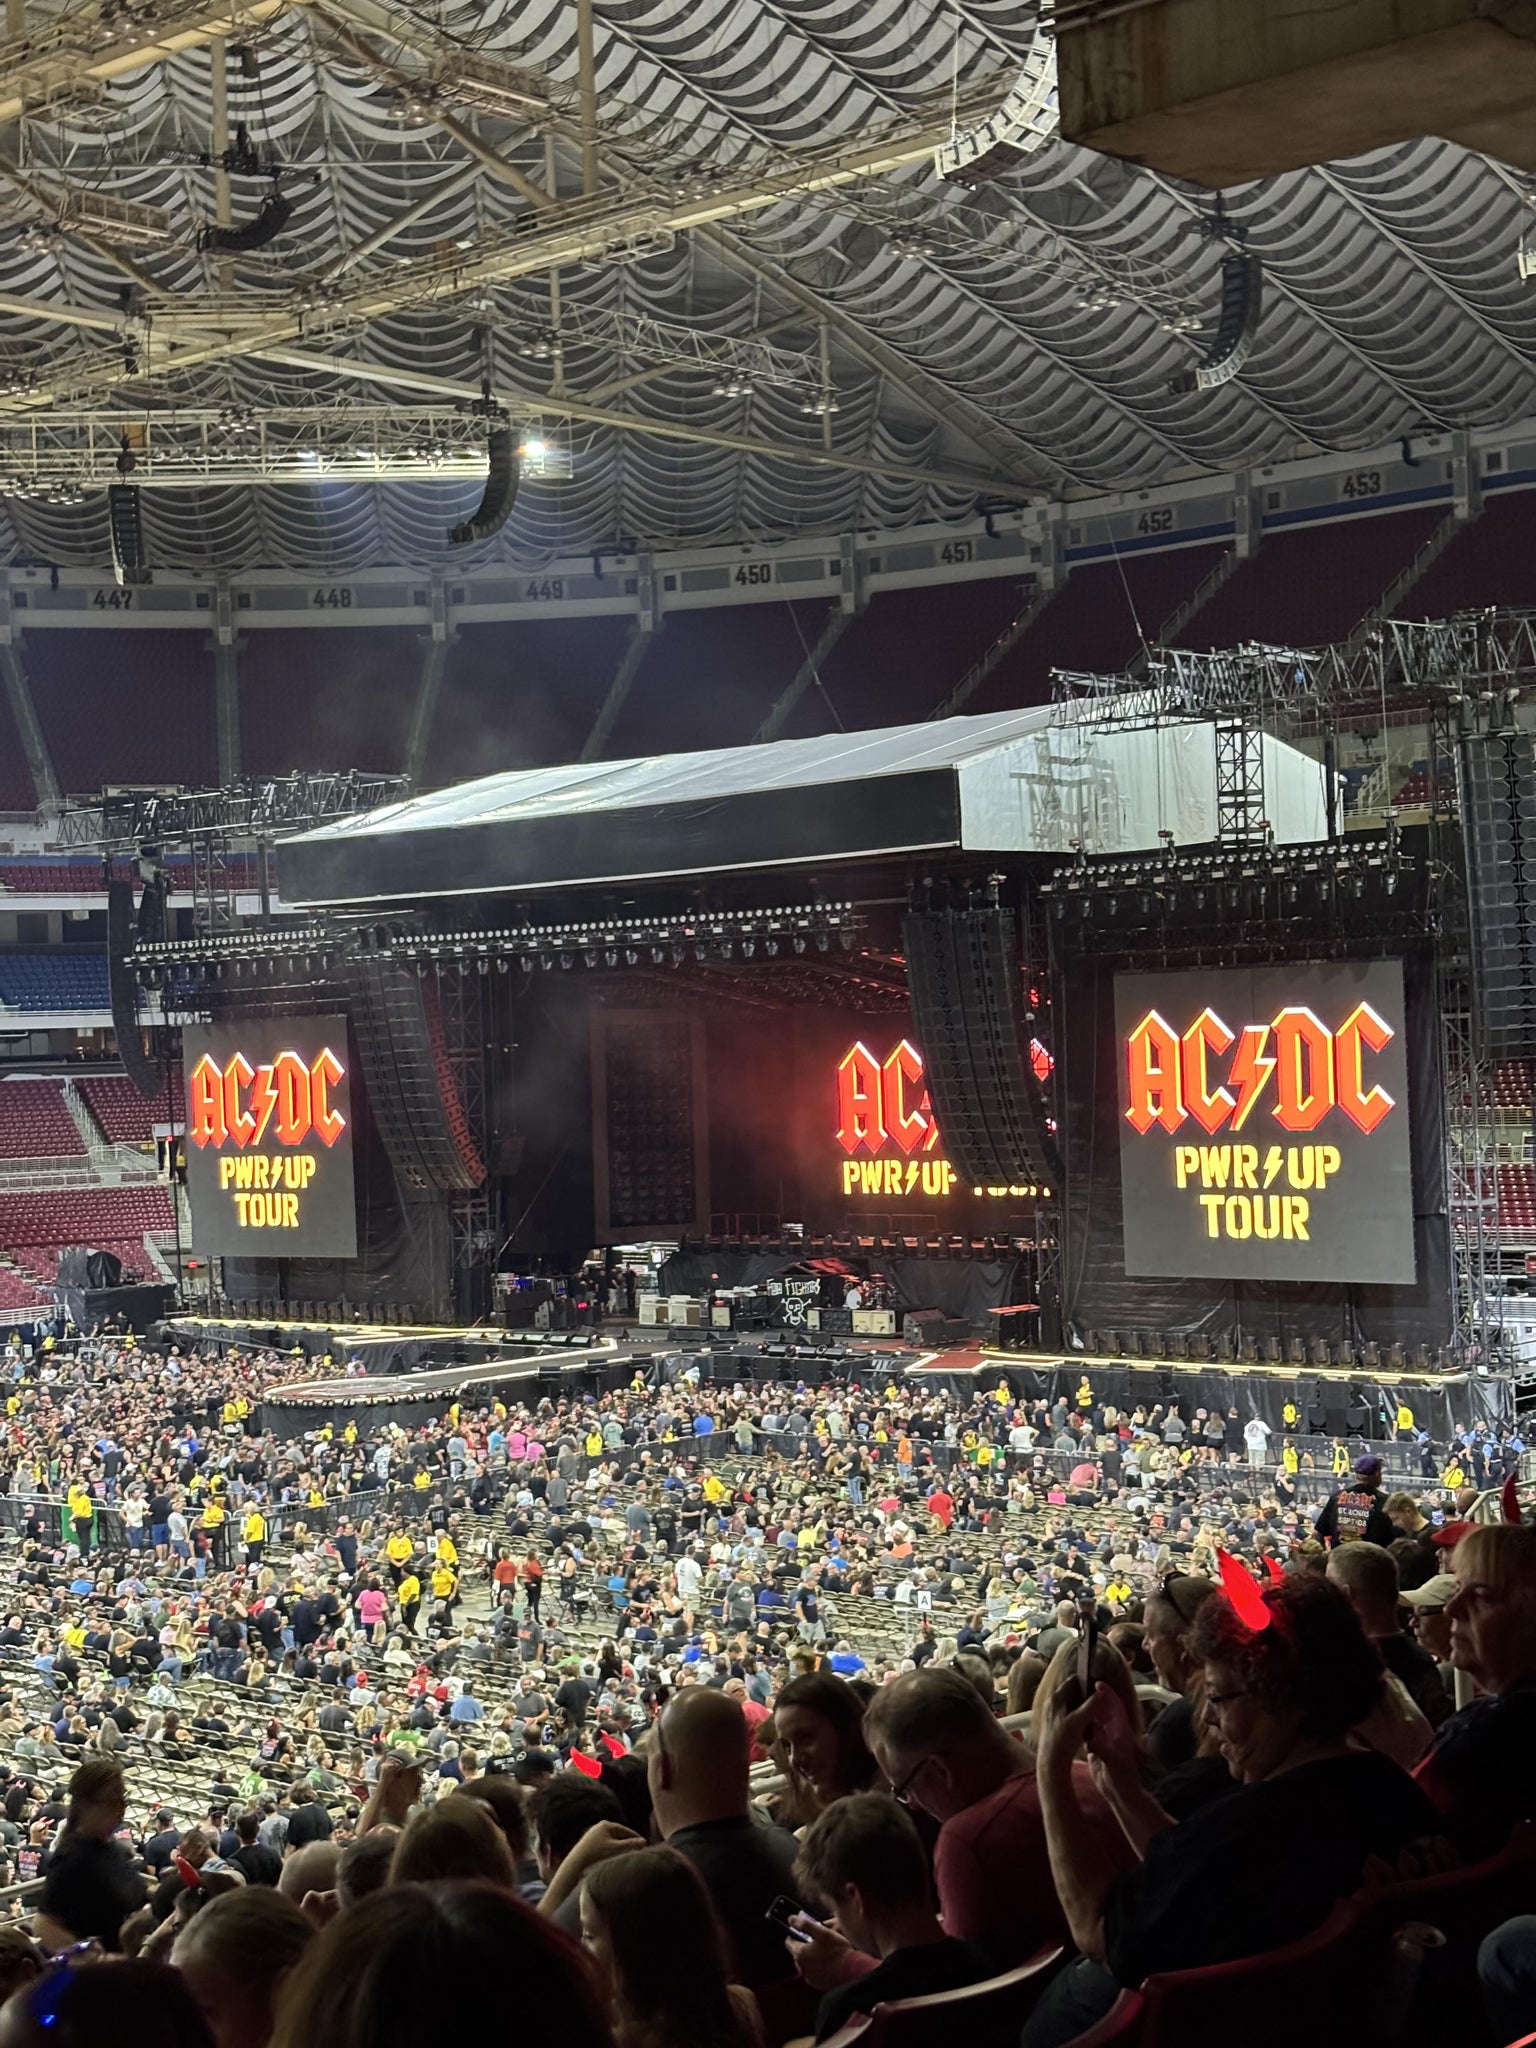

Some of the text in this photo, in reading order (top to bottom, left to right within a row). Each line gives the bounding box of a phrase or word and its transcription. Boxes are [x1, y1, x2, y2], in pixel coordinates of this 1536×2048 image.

[1342, 471, 1381, 497] 453
[1138, 509, 1173, 534] 452
[941, 541, 972, 564] 451
[735, 563, 771, 585] 450
[93, 589, 132, 609] 447
[313, 588, 352, 608] 448
[526, 579, 563, 599] 449
[234, 1192, 300, 1227] TOUR
[1199, 1194, 1310, 1240] TOUR
[921, 1595, 929, 1605] A
